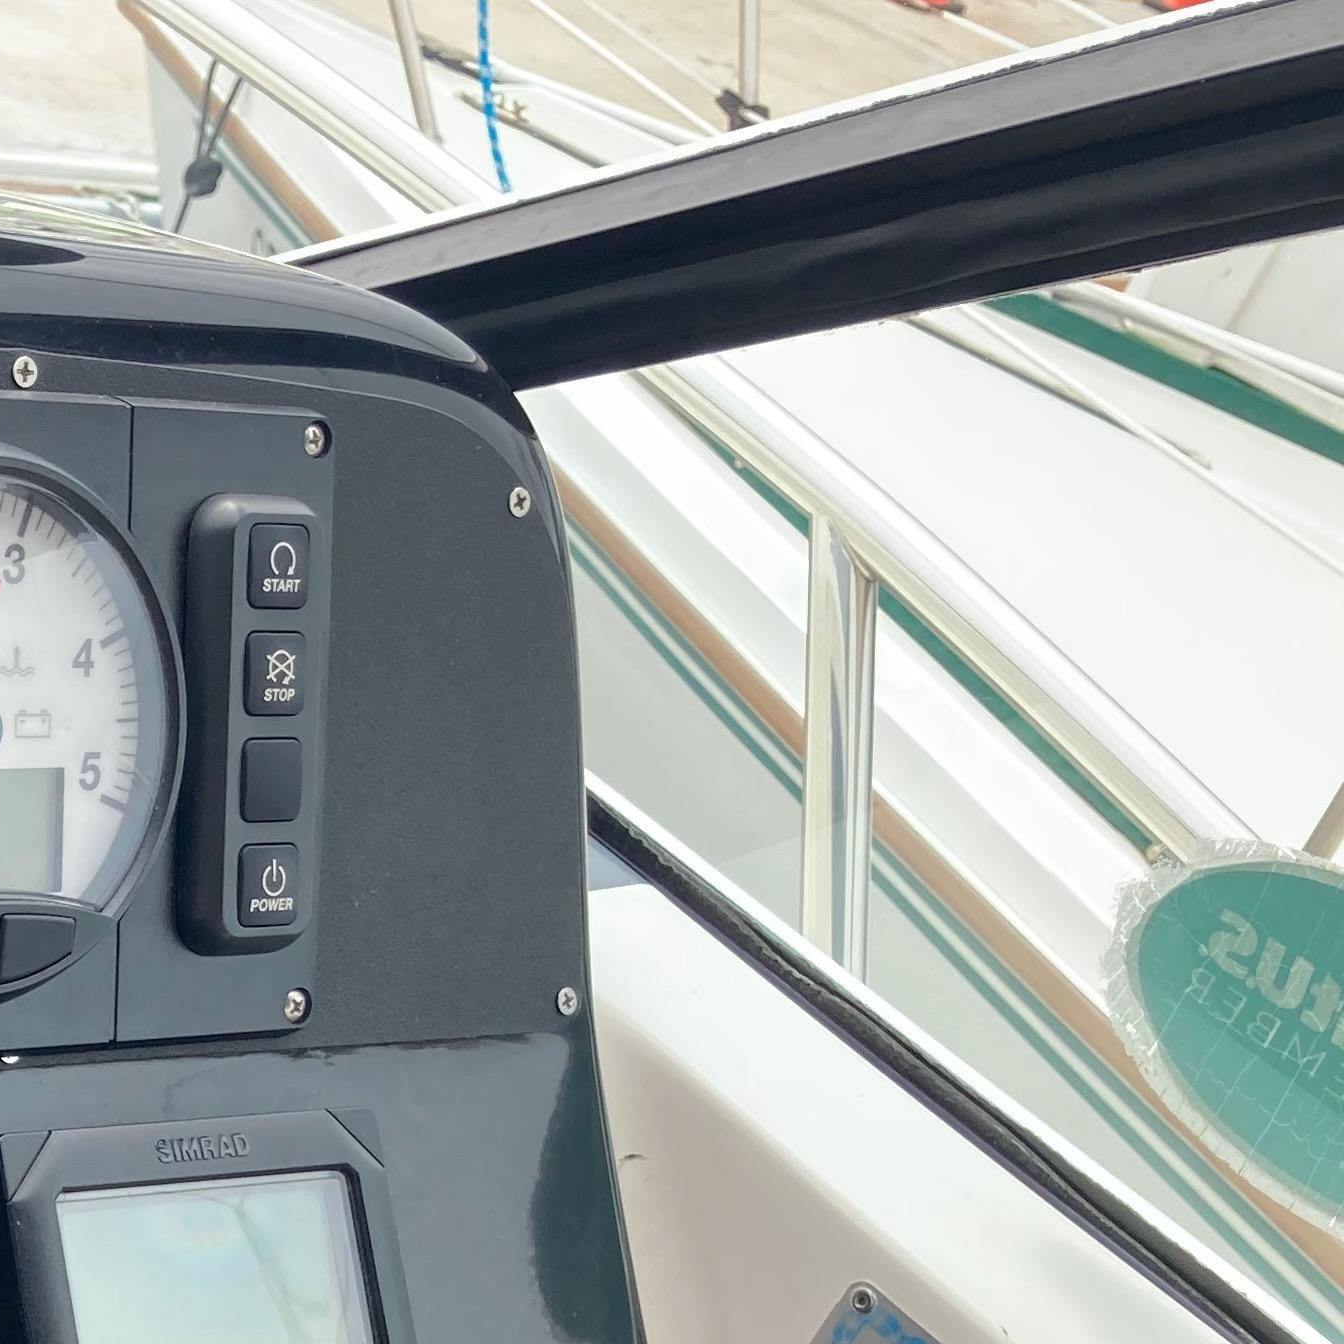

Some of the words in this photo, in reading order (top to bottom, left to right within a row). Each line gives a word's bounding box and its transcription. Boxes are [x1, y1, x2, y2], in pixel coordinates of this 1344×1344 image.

[3, 543, 25, 584] 3
[262, 578, 301, 593] START
[72, 638, 95, 678] 4
[263, 688, 295, 702] STOP
[79, 751, 101, 791] 5
[250, 897, 293, 912] POWER
[154, 1132, 250, 1165] SIMRAD
